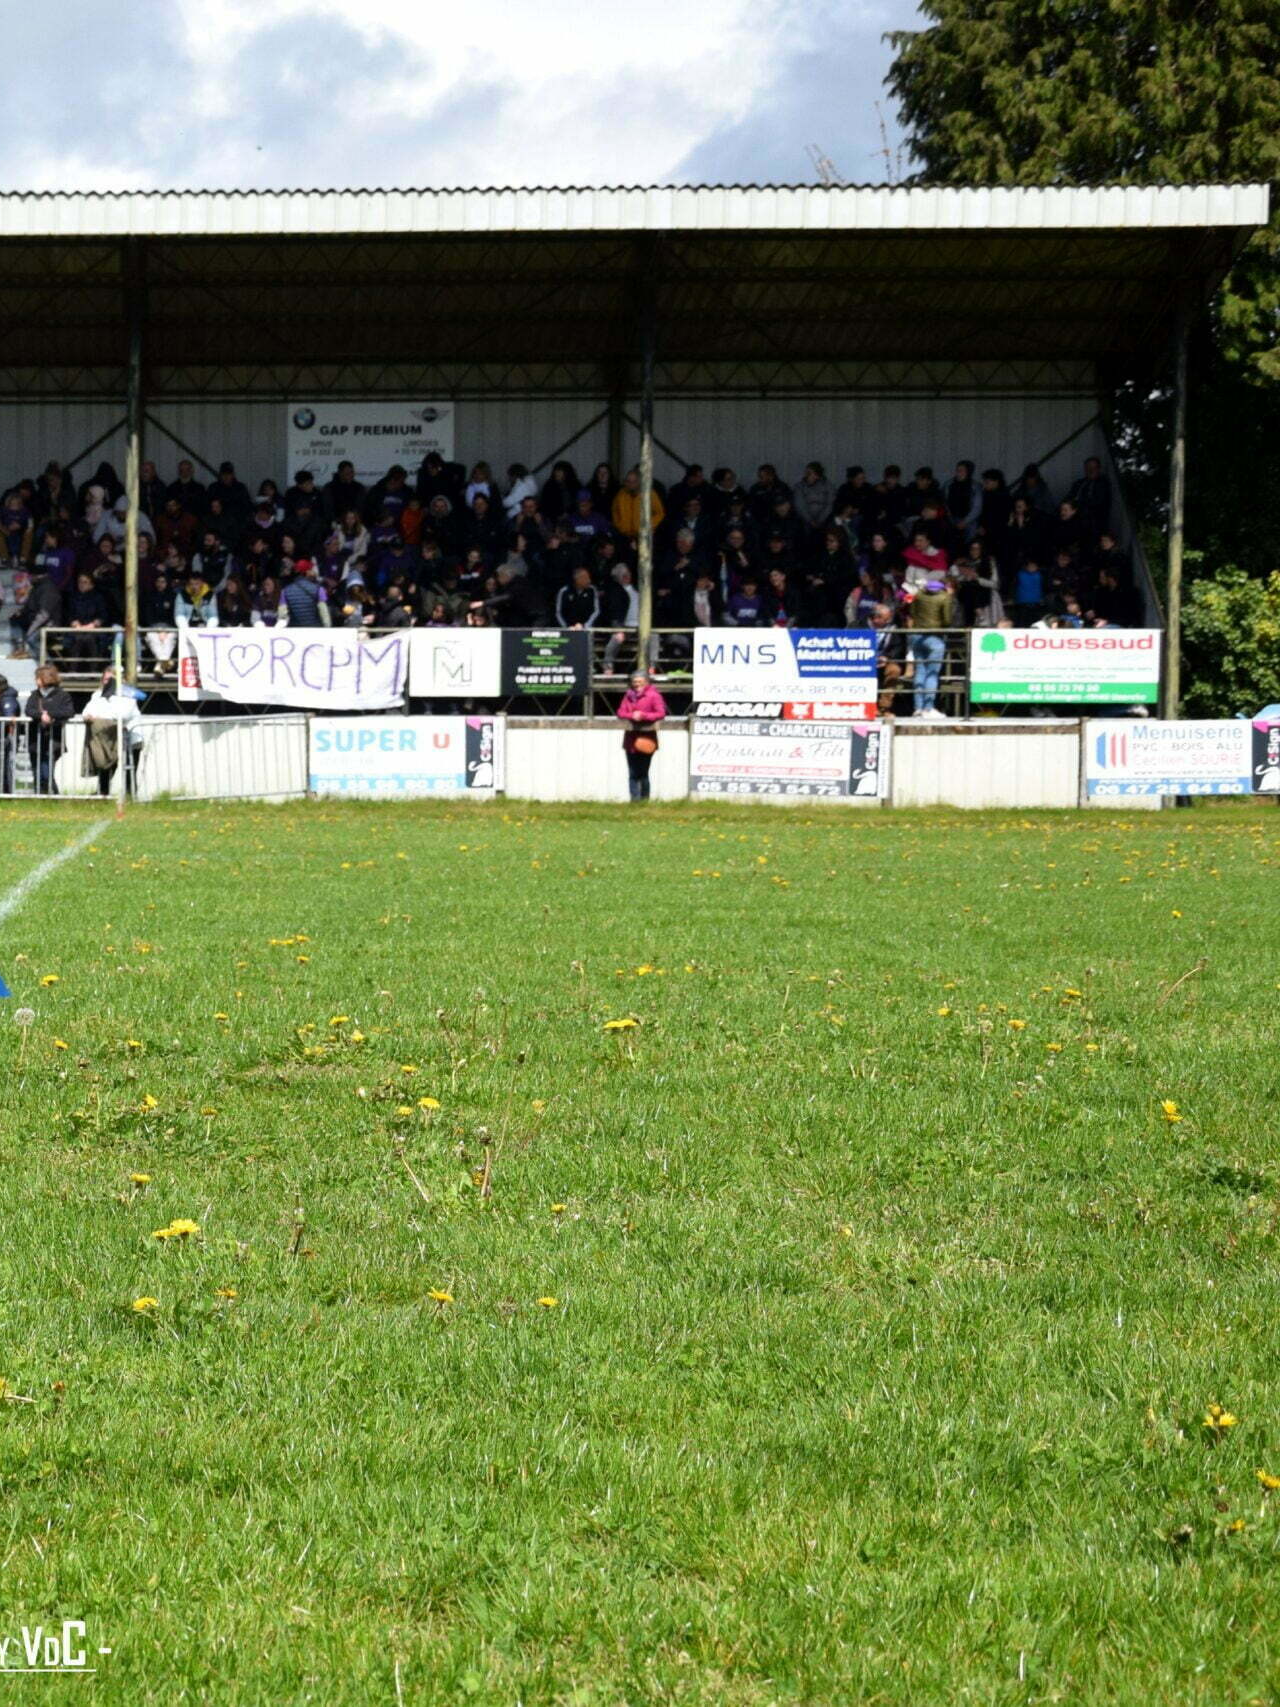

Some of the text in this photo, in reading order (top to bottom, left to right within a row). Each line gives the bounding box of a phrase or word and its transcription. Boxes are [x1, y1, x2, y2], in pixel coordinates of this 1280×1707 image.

[320, 425, 422, 436] GAP PREMIUM
[1013, 634, 1153, 650] doussaud
[701, 644, 776, 665] MNS
[847, 649, 875, 661] BTP
[696, 703, 782, 718] DOOSAN
[694, 721, 759, 736] BOUCHERIE
[769, 723, 848, 739] CHARCUTERIE
[1132, 725, 1243, 741] Menuiserie
[315, 729, 450, 752] SUPER U
[1171, 743, 1204, 751] BOIS
[1216, 742, 1243, 750] ALU
[697, 782, 721, 792] 05
[727, 783, 751, 793] 55
[756, 784, 781, 793] 73
[816, 785, 841, 795] 72
[1125, 784, 1150, 795] 47
